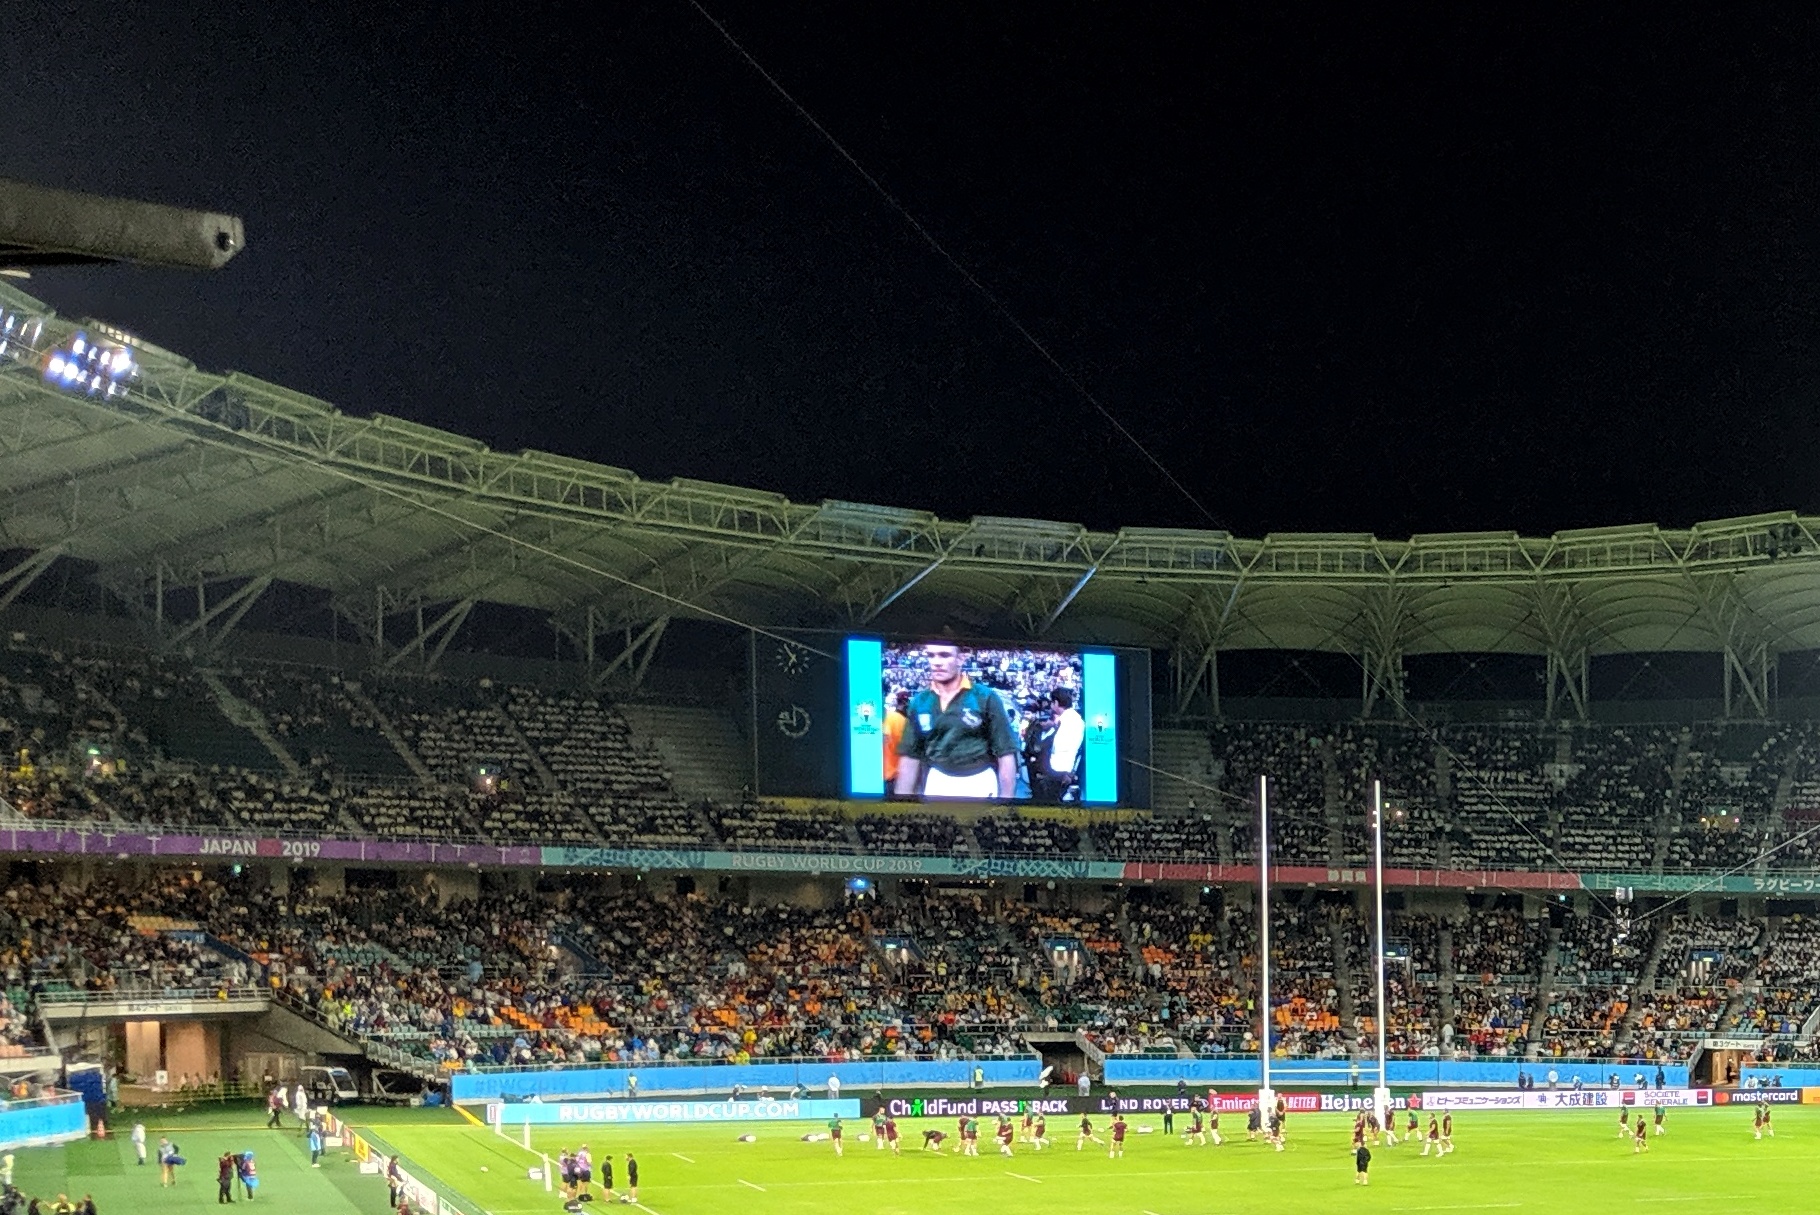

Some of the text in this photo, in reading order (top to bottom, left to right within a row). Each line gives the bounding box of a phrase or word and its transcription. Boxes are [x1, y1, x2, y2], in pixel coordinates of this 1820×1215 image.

[199, 838, 320, 857] JAPAN 2019
[731, 854, 923, 872] RUGBY WORLD CUP 2019
[1555, 1092, 1608, 1106] 大成建設
[1644, 1090, 1680, 1098] SOCIETE
[1732, 1089, 1798, 1103] mastercard
[982, 1101, 1018, 1114] PASS
[1032, 1100, 1068, 1113] BACK
[1101, 1098, 1138, 1110] LND
[1288, 1097, 1317, 1109] BETTER
[1321, 1094, 1406, 1111] Heineen
[1644, 1098, 1688, 1106] GENERALE
[559, 1102, 799, 1123] RUGBYWORLDCUP.COM
